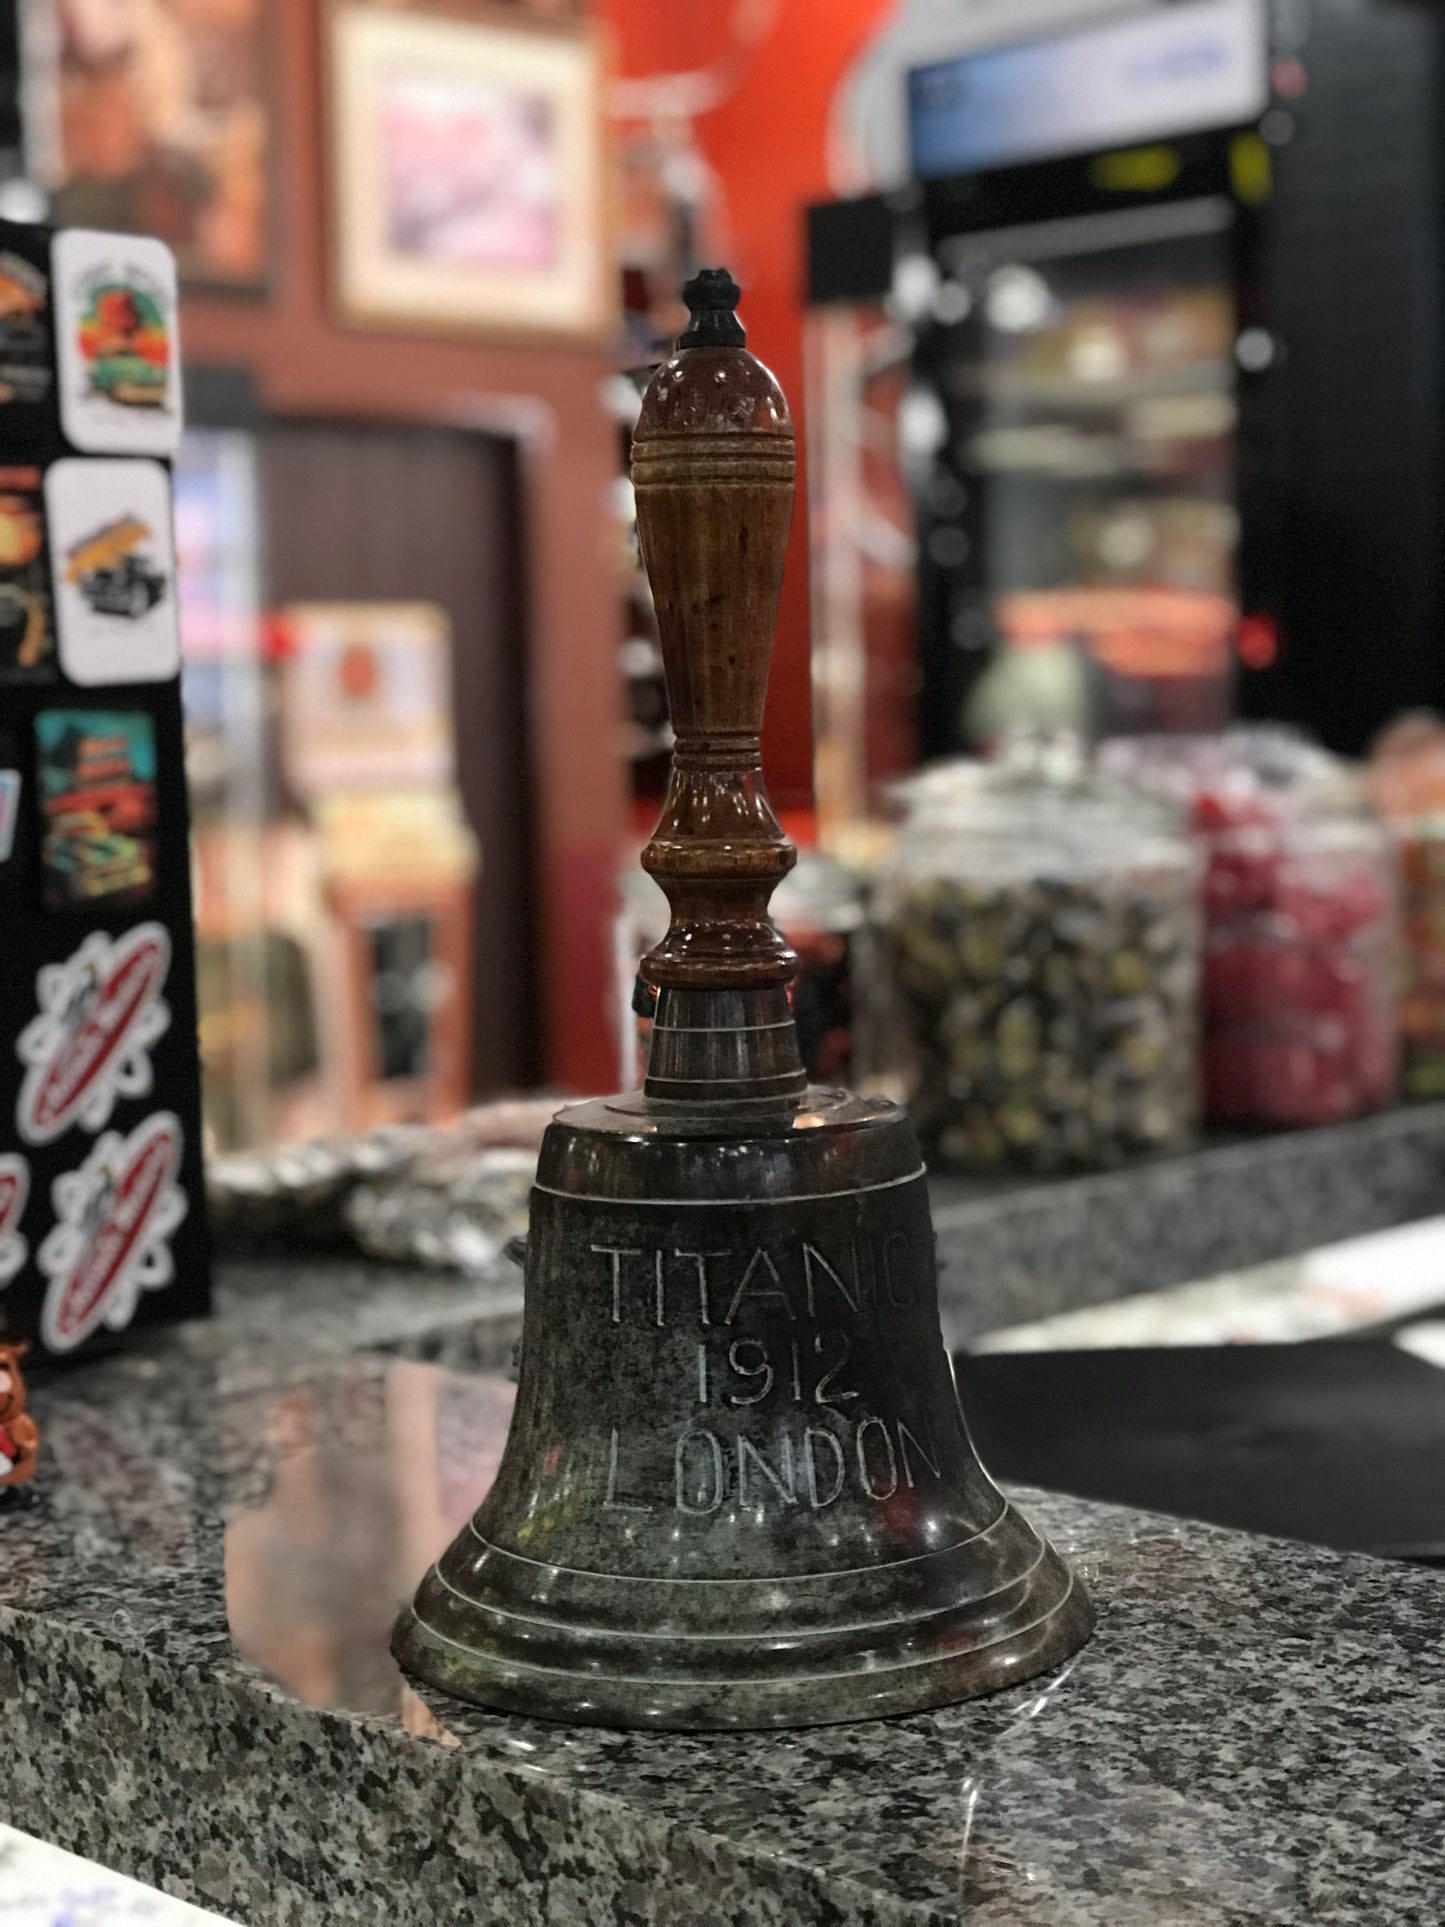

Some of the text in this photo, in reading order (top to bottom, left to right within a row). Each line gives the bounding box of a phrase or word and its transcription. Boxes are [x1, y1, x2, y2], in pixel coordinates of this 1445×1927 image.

[590, 1232, 911, 1326] TITANIC
[698, 1333, 861, 1405] 1912
[603, 1416, 941, 1515] LONDON
